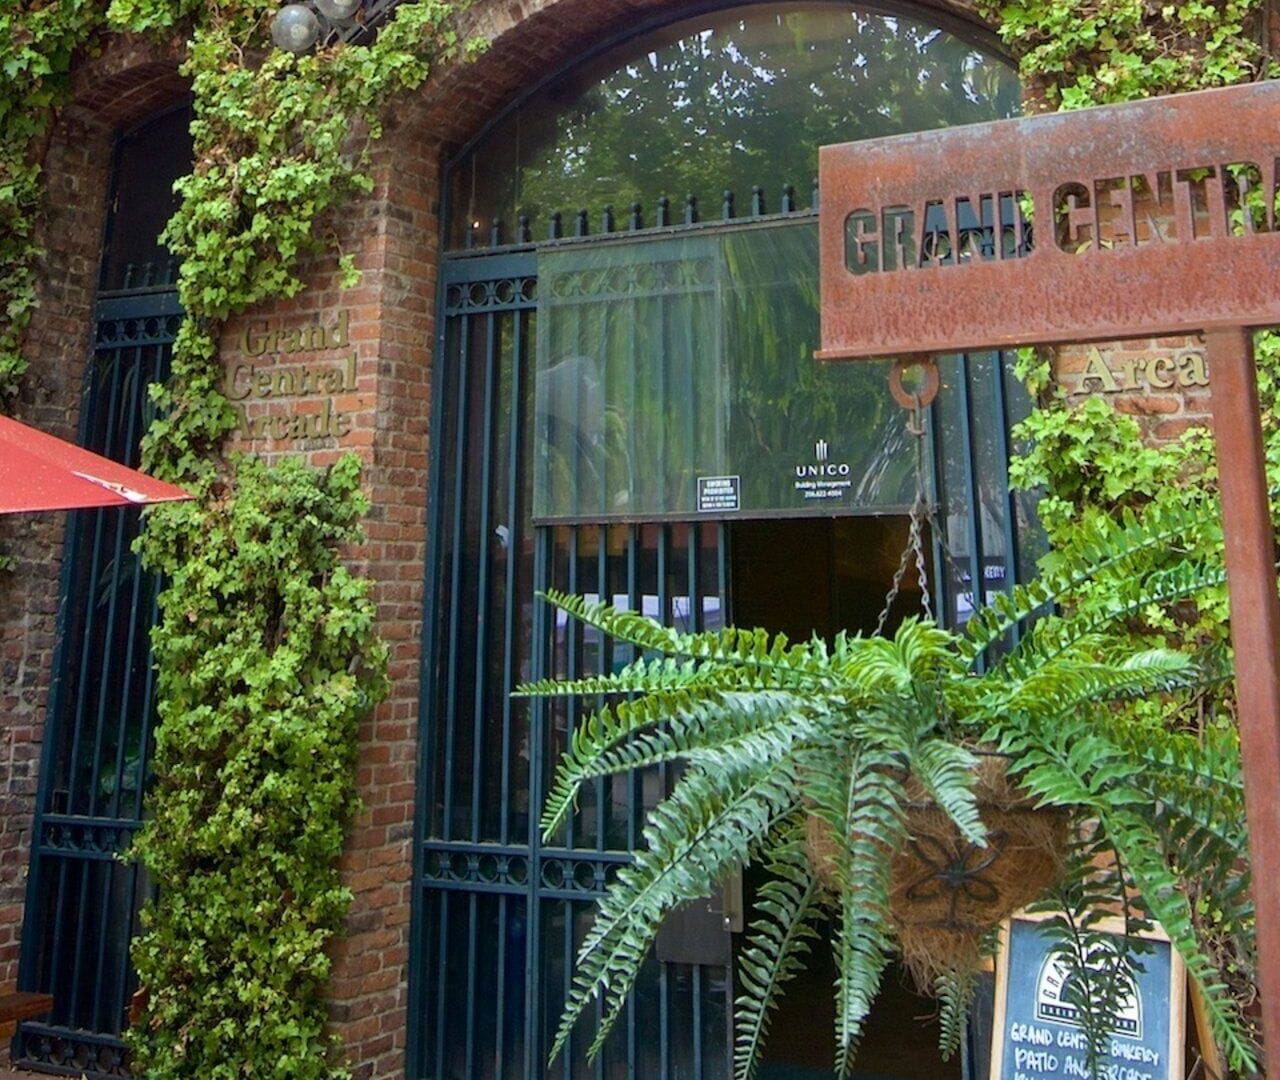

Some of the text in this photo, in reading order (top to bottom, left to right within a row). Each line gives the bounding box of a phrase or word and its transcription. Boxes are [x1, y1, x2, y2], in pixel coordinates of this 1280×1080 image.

[843, 188, 1035, 277] GRAND
[239, 310, 350, 358] Grand
[223, 353, 359, 401] Central
[1073, 345, 1210, 396] Arca
[234, 399, 351, 441] Arcade
[795, 463, 850, 477] UNICO
[1010, 1022, 1053, 1046] GRAND
[1110, 1039, 1160, 1067] BAKERY
[1014, 1047, 1059, 1072] PATIO
